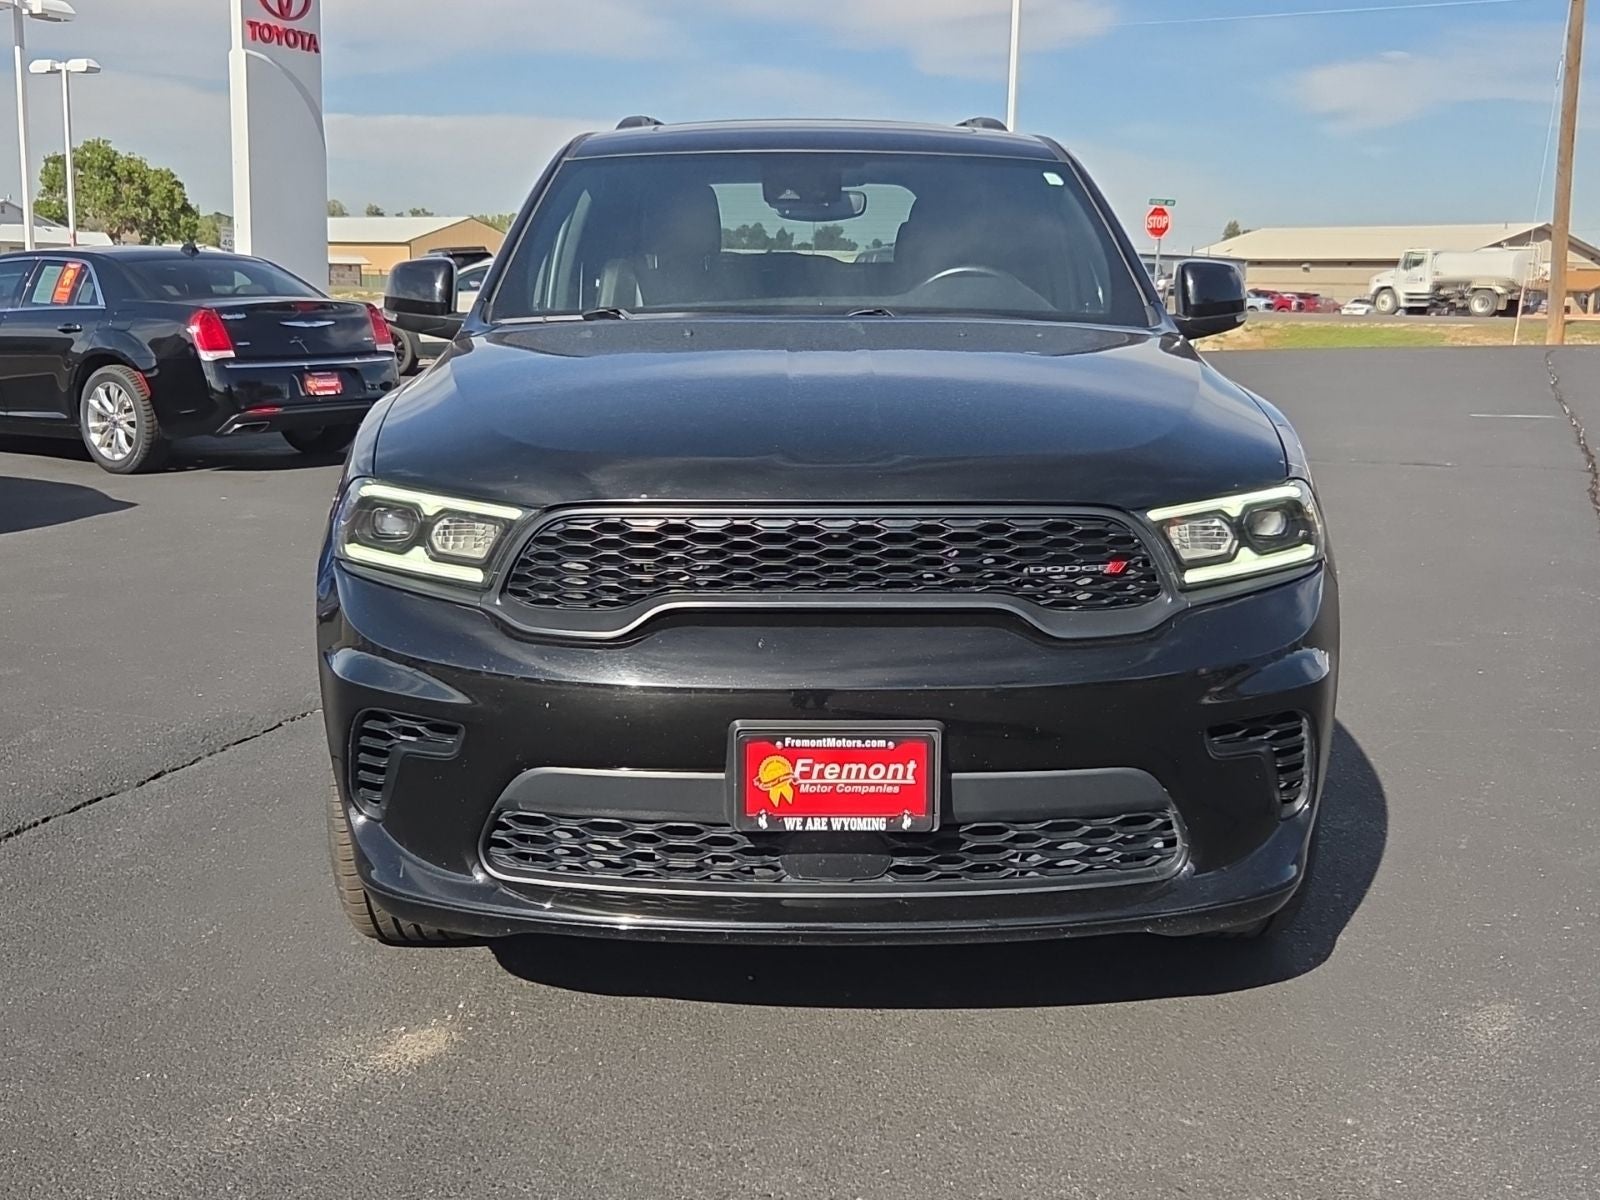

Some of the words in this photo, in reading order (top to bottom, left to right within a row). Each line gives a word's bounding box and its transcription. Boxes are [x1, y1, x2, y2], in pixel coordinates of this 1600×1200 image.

[246, 20, 320, 54] TOYOTA
[1147, 215, 1168, 229] STOP
[1029, 564, 1110, 574] DODGE
[784, 737, 886, 748] FremontMotors.com
[794, 758, 917, 780] Fremont
[799, 783, 833, 793] Motor
[835, 783, 900, 795] Companies
[784, 817, 805, 831] WE
[805, 817, 829, 831] ARE
[831, 817, 886, 831] WYOMING
